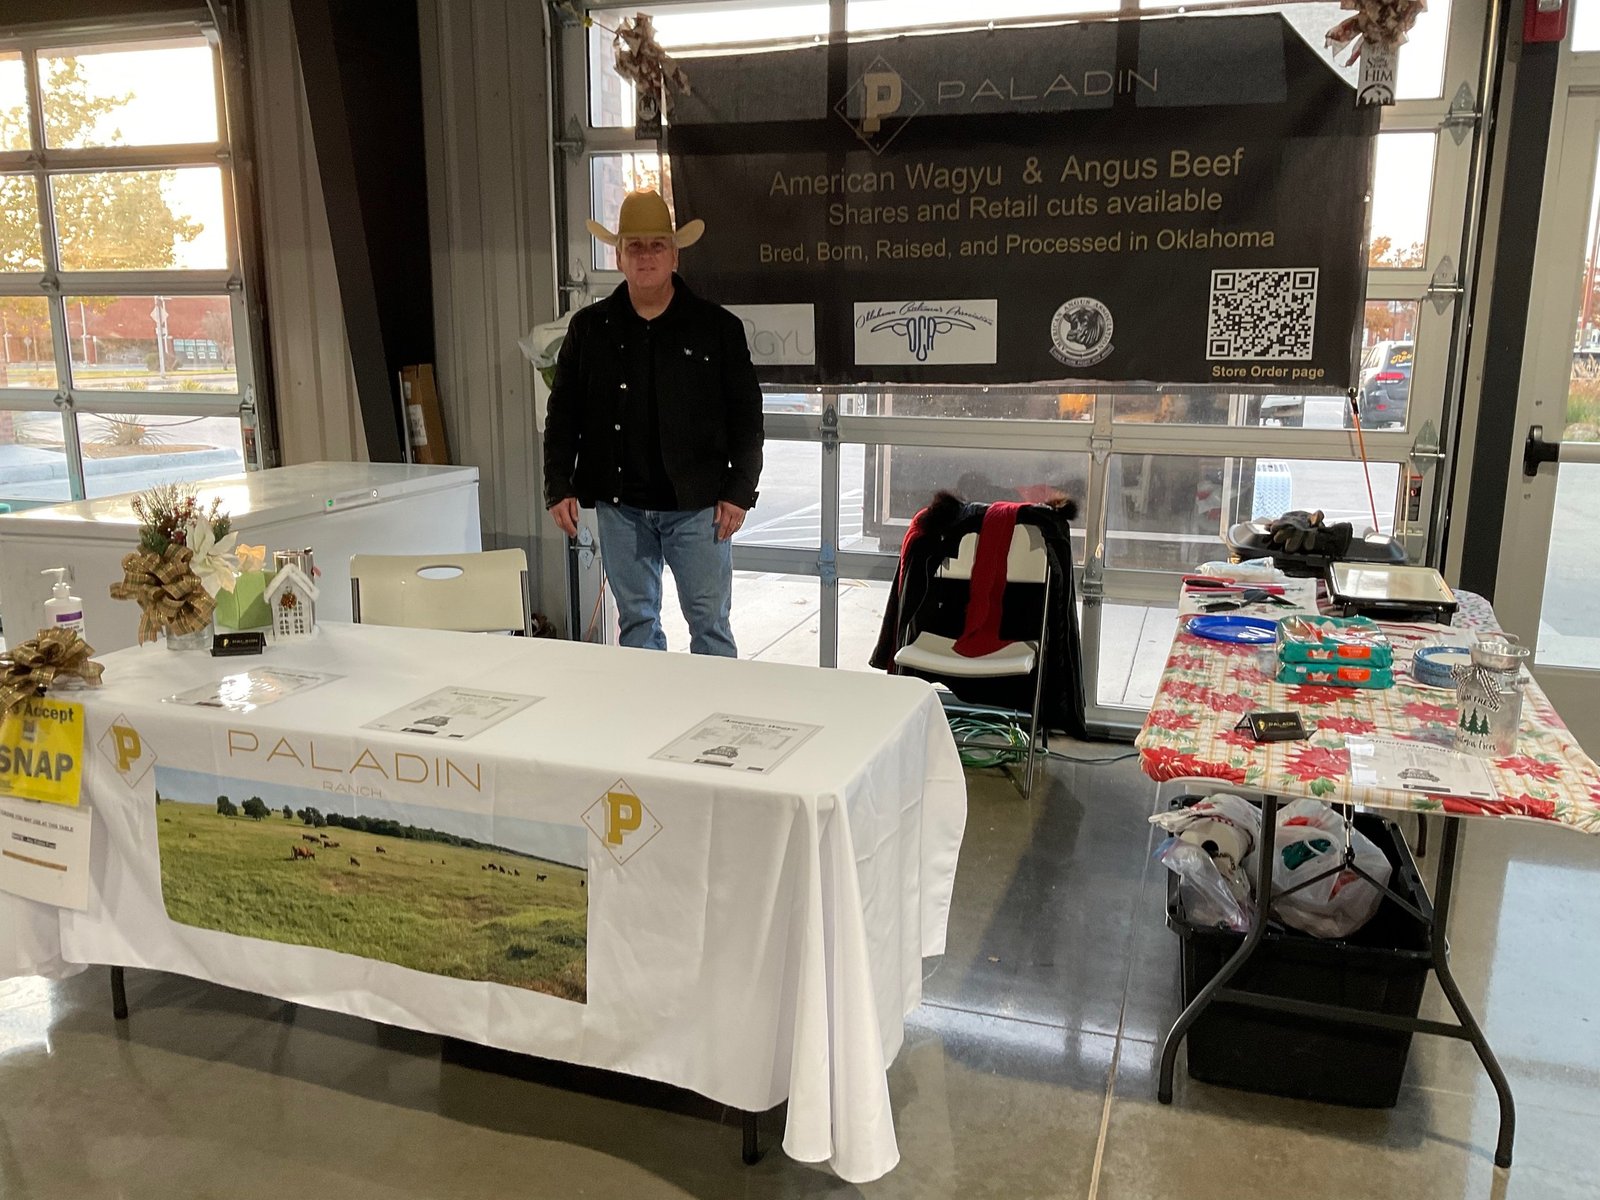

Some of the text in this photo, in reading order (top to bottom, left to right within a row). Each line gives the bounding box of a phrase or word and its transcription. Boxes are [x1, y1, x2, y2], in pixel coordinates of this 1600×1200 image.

[938, 68, 1158, 104] PALADIN
[1365, 70, 1392, 81] HIM
[860, 73, 901, 135] P
[769, 147, 1245, 197] American Wagyu & Angus Beef
[829, 187, 1223, 226] Shares and Retail cuts available
[759, 227, 1275, 264] Bred, Born, Raised, and Processed in Oklahoma
[1212, 365, 1325, 380] Store Order page
[24, 701, 74, 724] Accept
[0, 744, 73, 782] SNAP
[111, 725, 142, 773] P
[227, 728, 481, 792] PALADIN
[322, 780, 383, 798] RANCH
[602, 792, 642, 847] P
